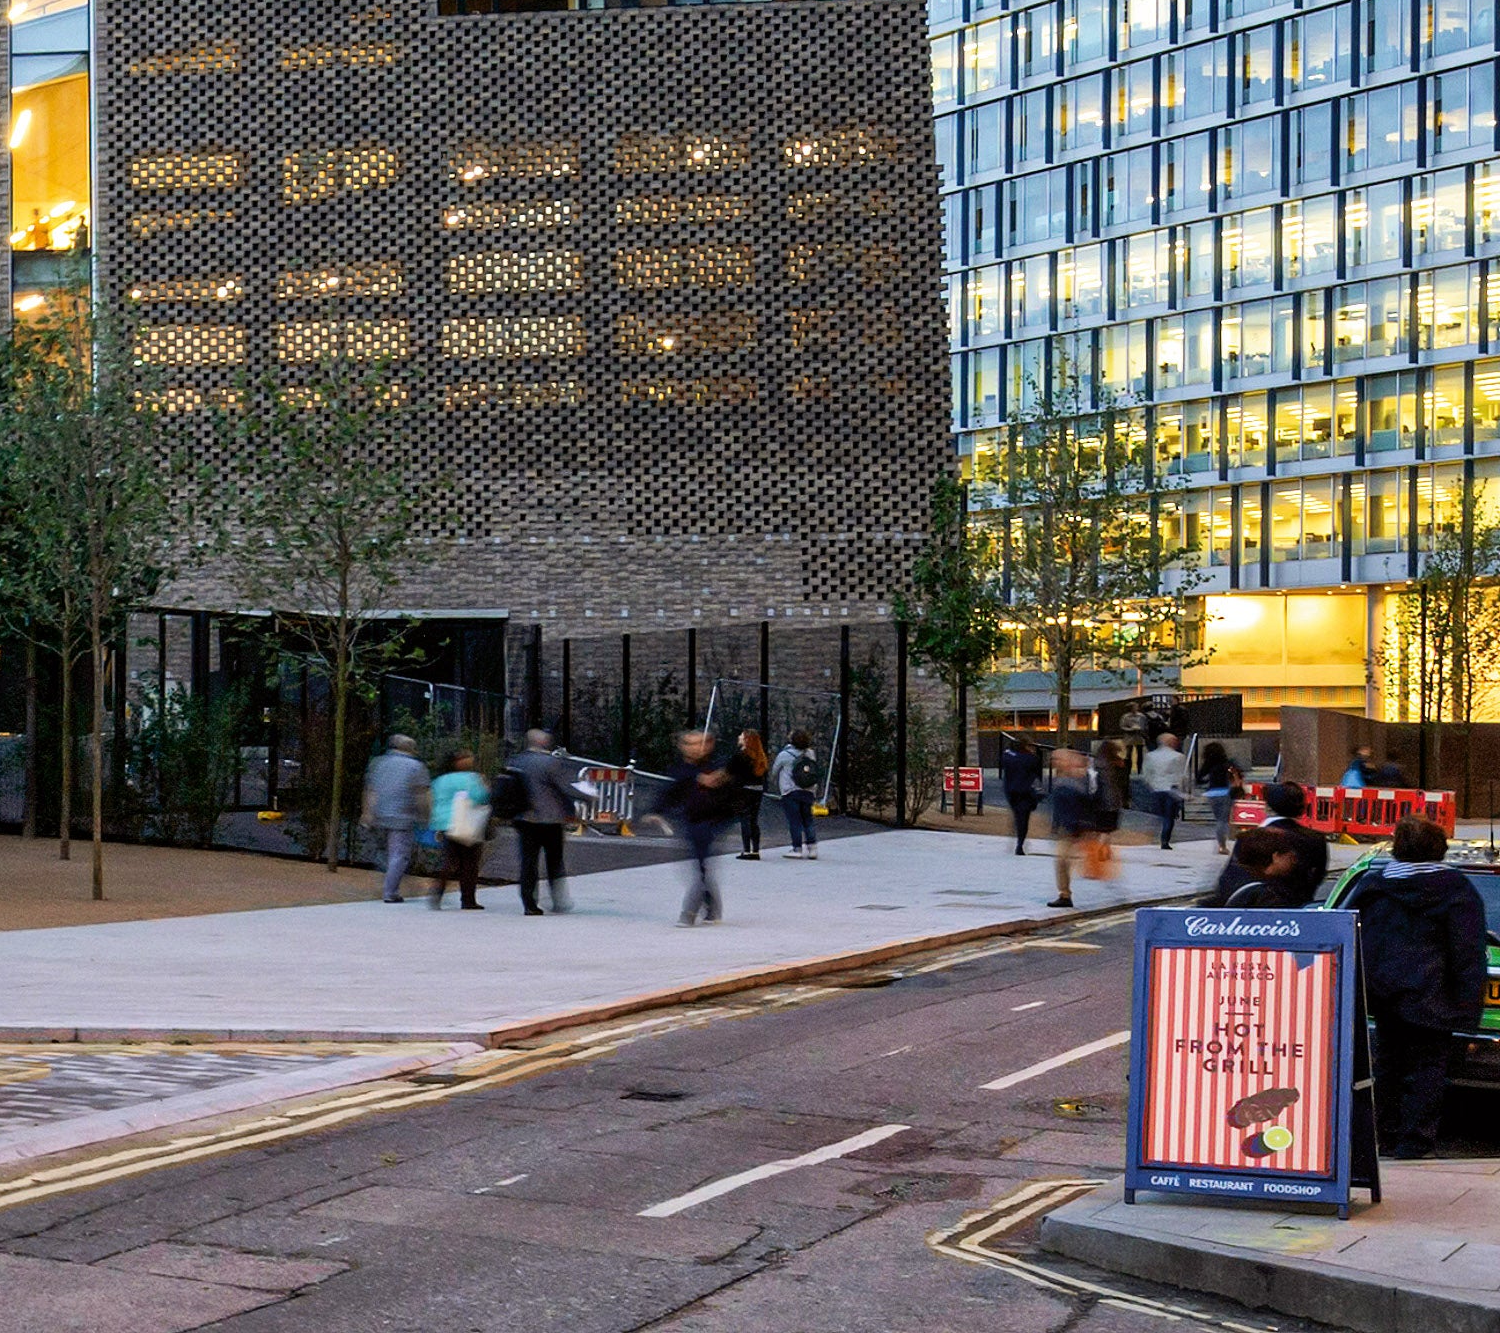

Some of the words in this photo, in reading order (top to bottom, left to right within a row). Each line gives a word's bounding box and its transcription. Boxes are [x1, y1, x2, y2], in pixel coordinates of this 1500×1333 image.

[1184, 915, 1301, 937] Carluccio's
[1232, 962, 1271, 971] FESTA
[1206, 971, 1275, 981] ALFRESCO
[1219, 996, 1261, 1007] JUNE
[1214, 1022, 1265, 1038] HOT
[1175, 1039, 1245, 1056] FROM
[1257, 1041, 1304, 1058] THE
[1202, 1059, 1274, 1075] GRILL
[1189, 1178, 1254, 1191] RESTAURANT
[1264, 1183, 1321, 1195] FOODSHOP
